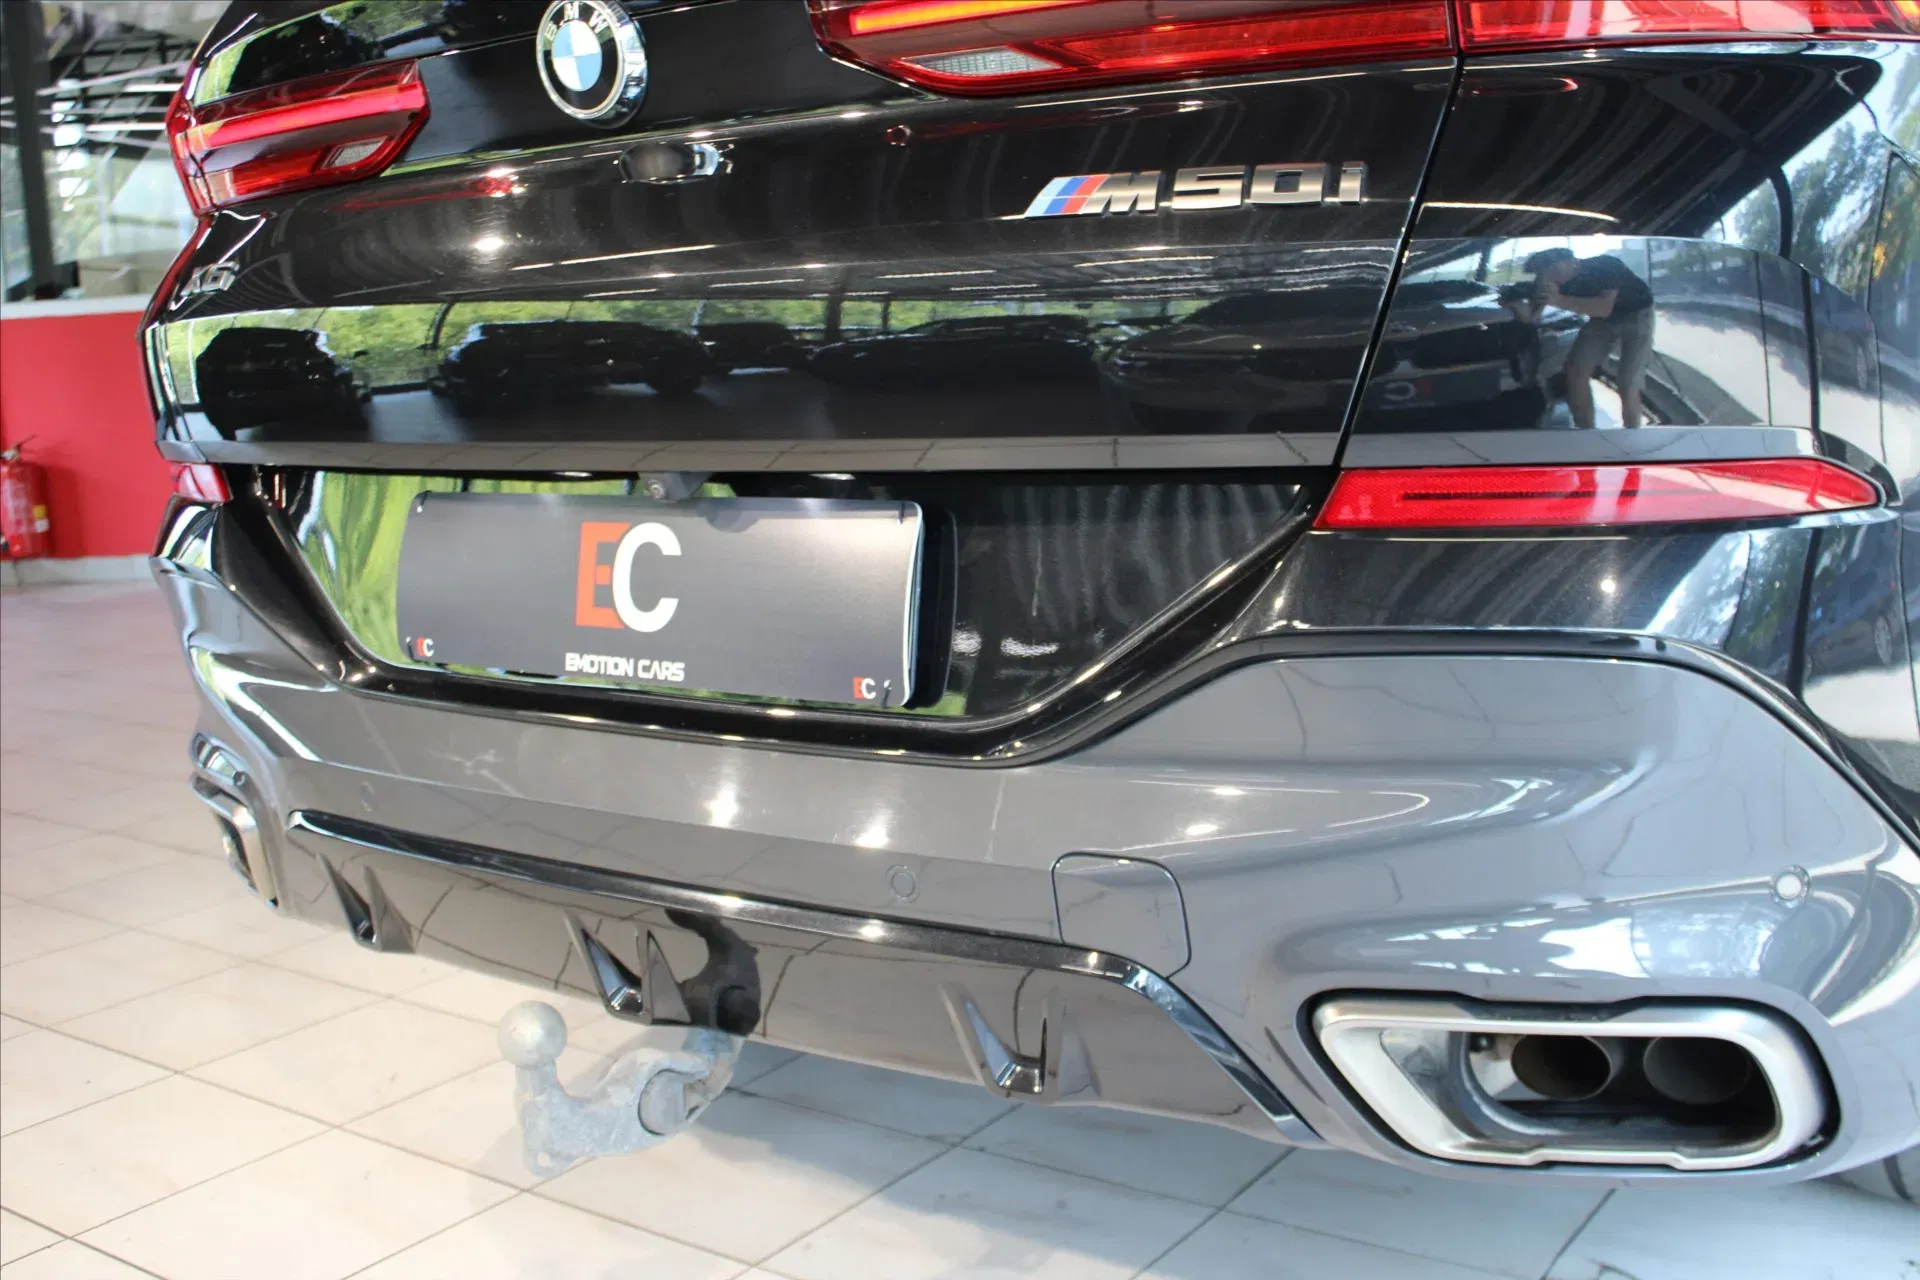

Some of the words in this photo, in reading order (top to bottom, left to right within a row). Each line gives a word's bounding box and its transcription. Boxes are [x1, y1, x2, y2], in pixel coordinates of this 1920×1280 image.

[544, 2, 609, 40] BMW
[1077, 161, 1364, 216] M50i
[575, 520, 682, 633] EC
[564, 652, 635, 677] EMOTION
[637, 659, 686, 682] CARS
[852, 676, 876, 699] EC
